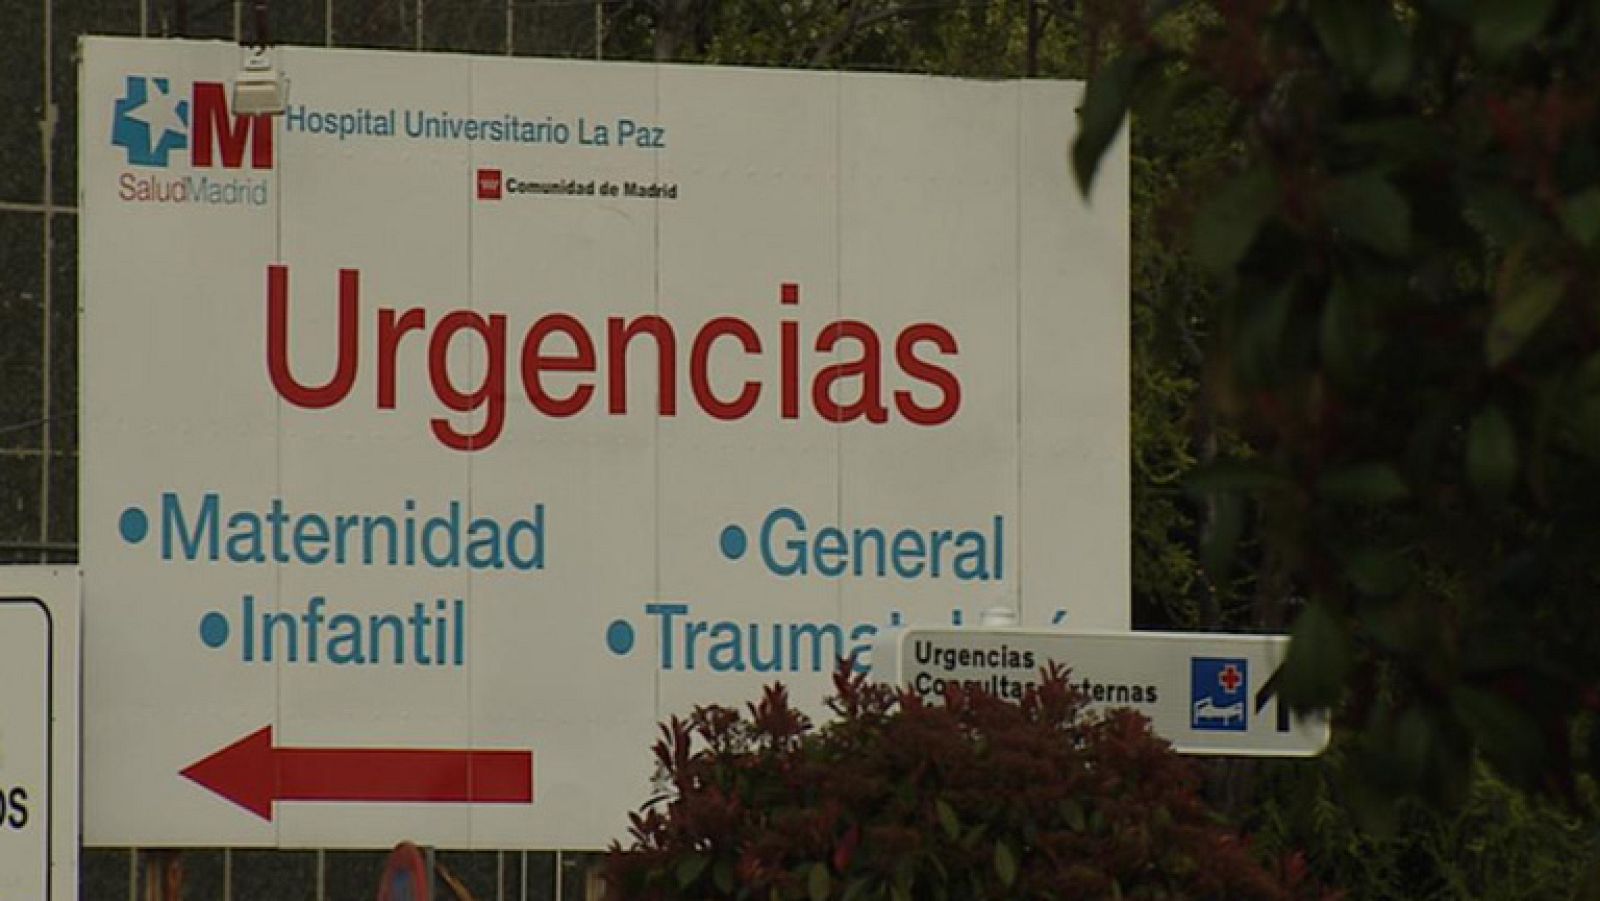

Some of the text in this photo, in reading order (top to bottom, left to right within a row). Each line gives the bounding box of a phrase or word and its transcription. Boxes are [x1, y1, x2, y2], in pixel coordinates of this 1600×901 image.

[286, 106, 666, 148] Hospital Universitario La Paz
[505, 177, 678, 199] Comunidad de Madrid
[266, 264, 962, 451] Urgencias
[161, 492, 546, 570] Maternidad
[759, 508, 1005, 581] General
[241, 595, 465, 666] Infantil
[914, 640, 1035, 670] Urgencias
